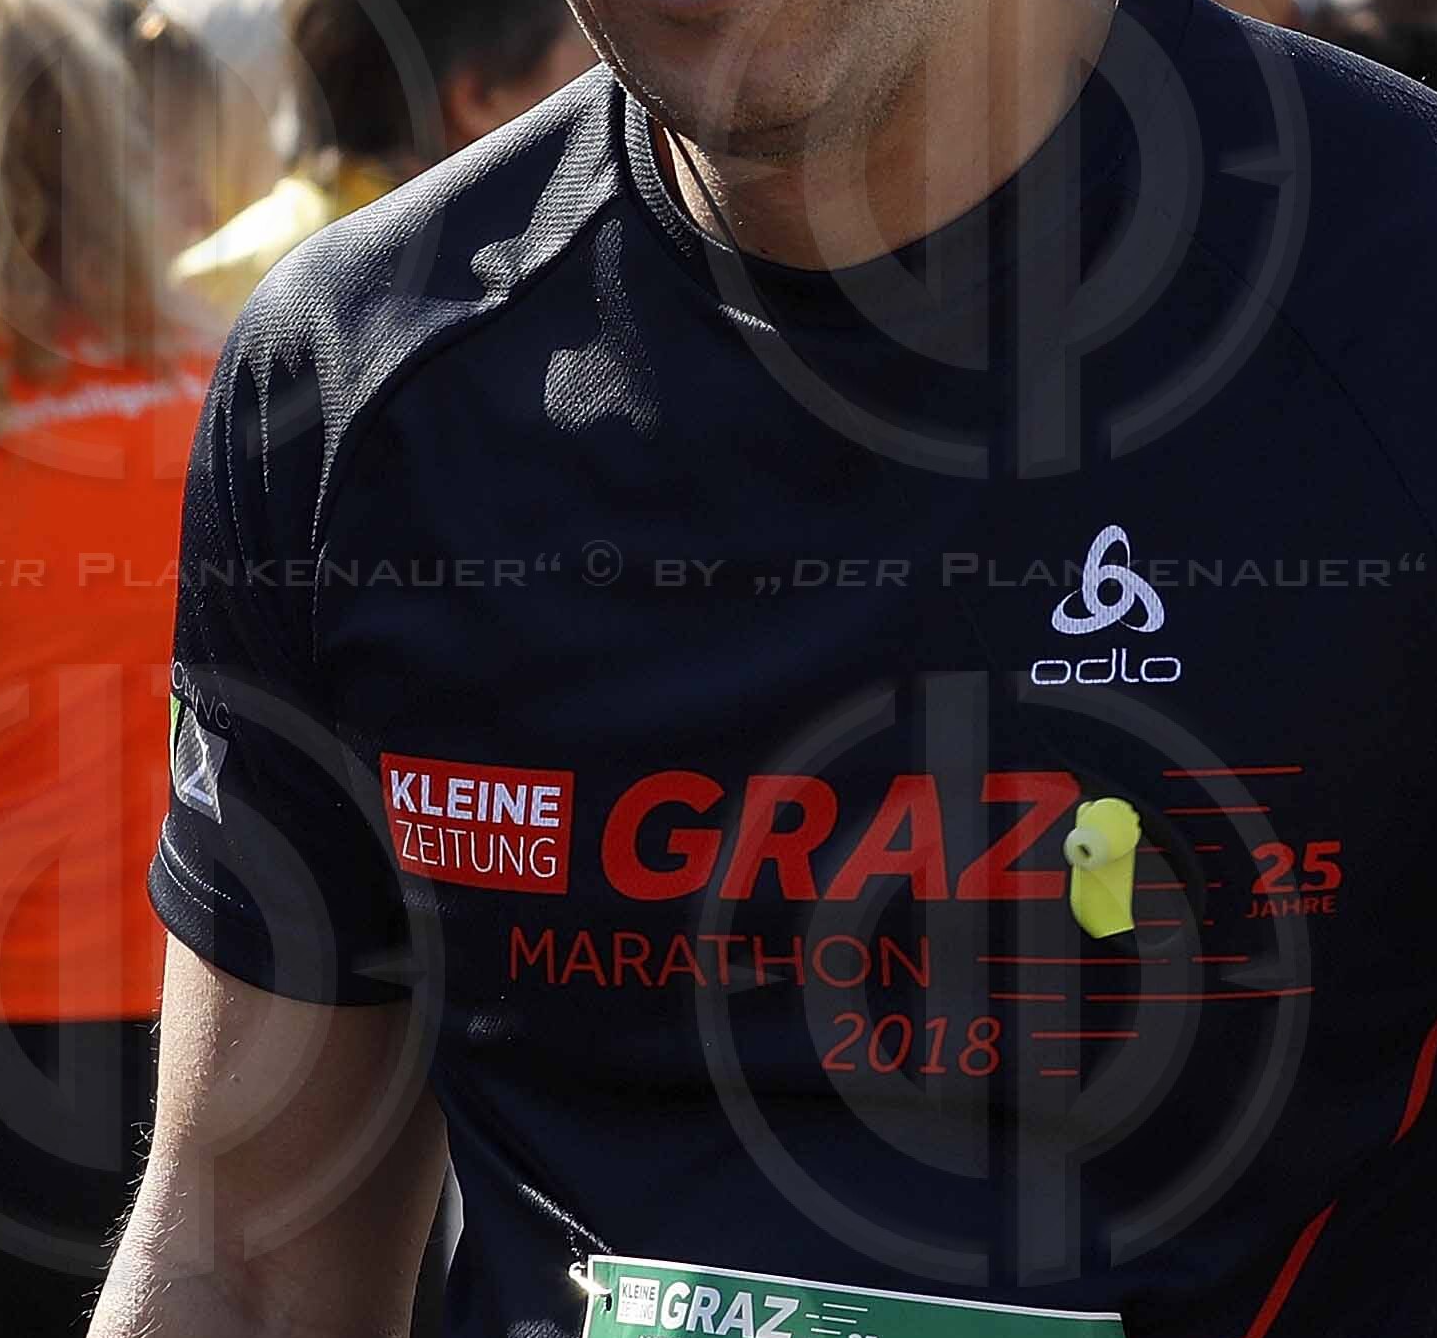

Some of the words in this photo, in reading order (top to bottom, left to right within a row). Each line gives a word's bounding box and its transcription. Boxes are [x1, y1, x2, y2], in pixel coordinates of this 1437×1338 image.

[1031, 648, 1181, 686] odlo
[390, 769, 561, 826] KLEINE
[395, 817, 558, 879] ZEITUNG
[602, 771, 1082, 901] GRAZ
[1251, 840, 1342, 894] 25
[1247, 894, 1337, 919] JAHRE
[508, 926, 930, 988] MARATHON
[822, 1014, 1001, 1078] 2018
[622, 1282, 656, 1301] KLEINE
